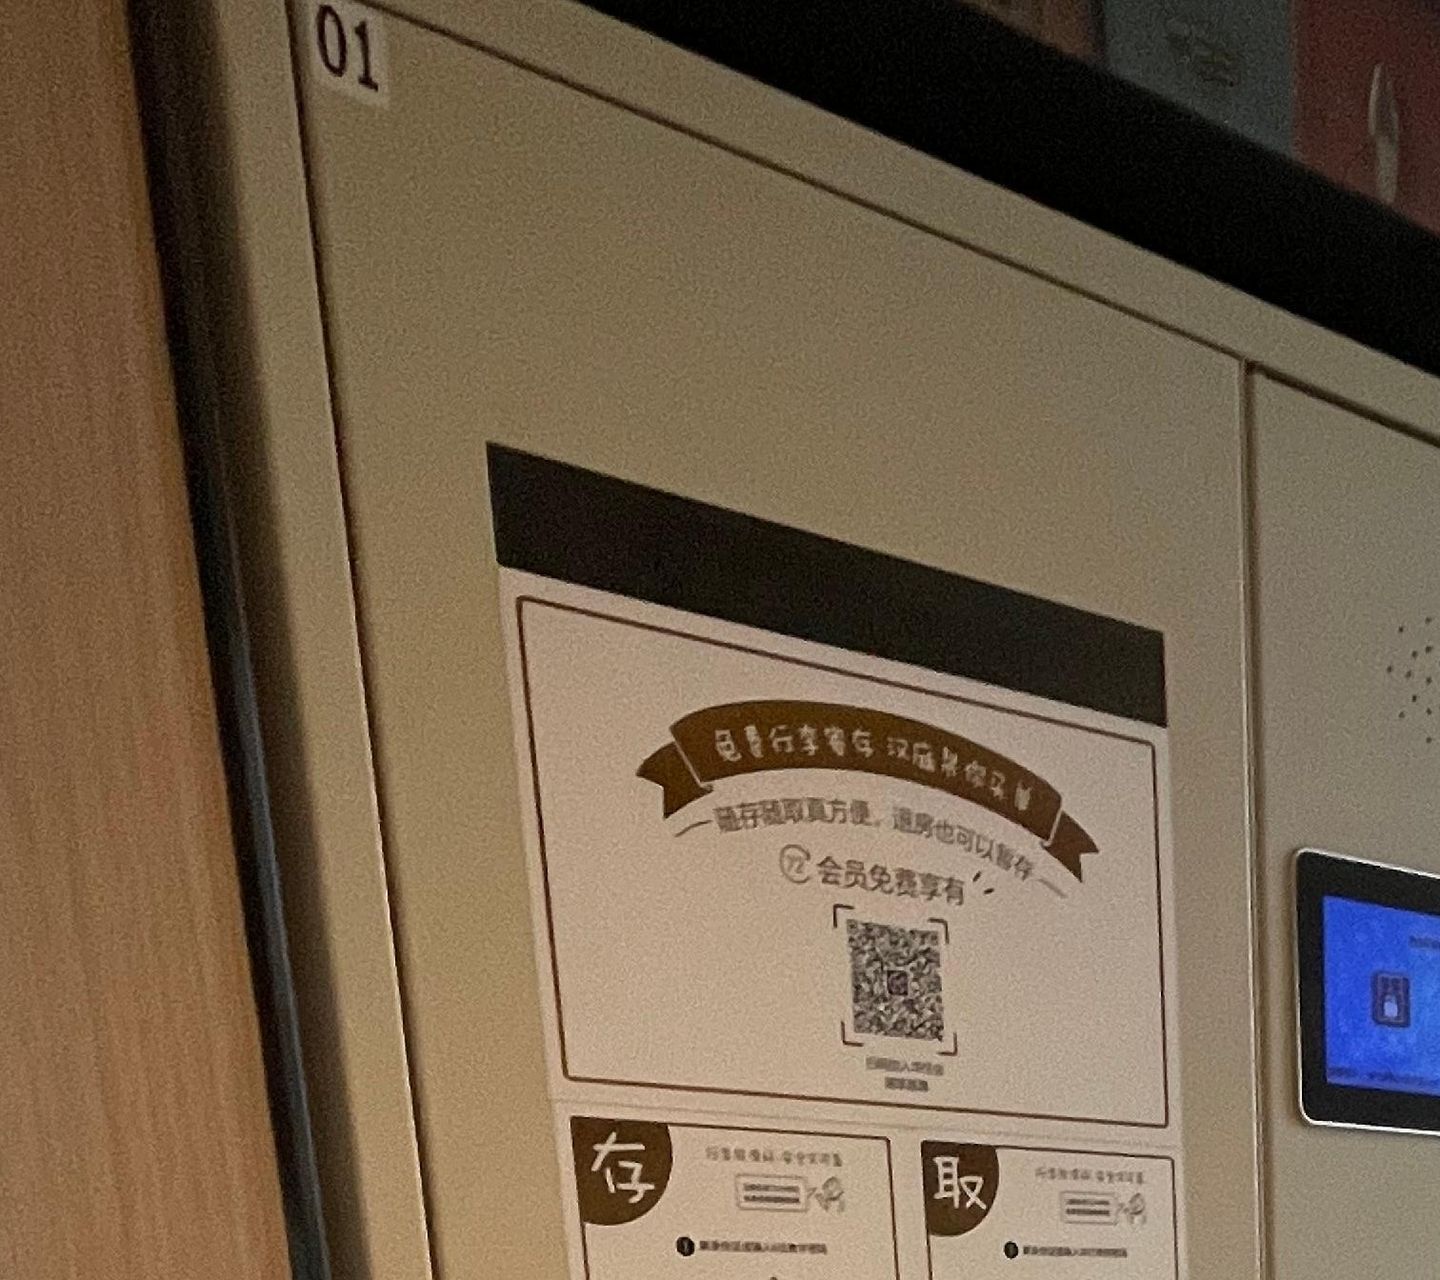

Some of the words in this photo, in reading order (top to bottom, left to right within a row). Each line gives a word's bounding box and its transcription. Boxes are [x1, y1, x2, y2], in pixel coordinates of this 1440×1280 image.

[316, 3, 379, 93] 01
[816, 855, 966, 906] 会员免费享有
[590, 1130, 656, 1205] 存
[932, 1155, 988, 1212] 取
